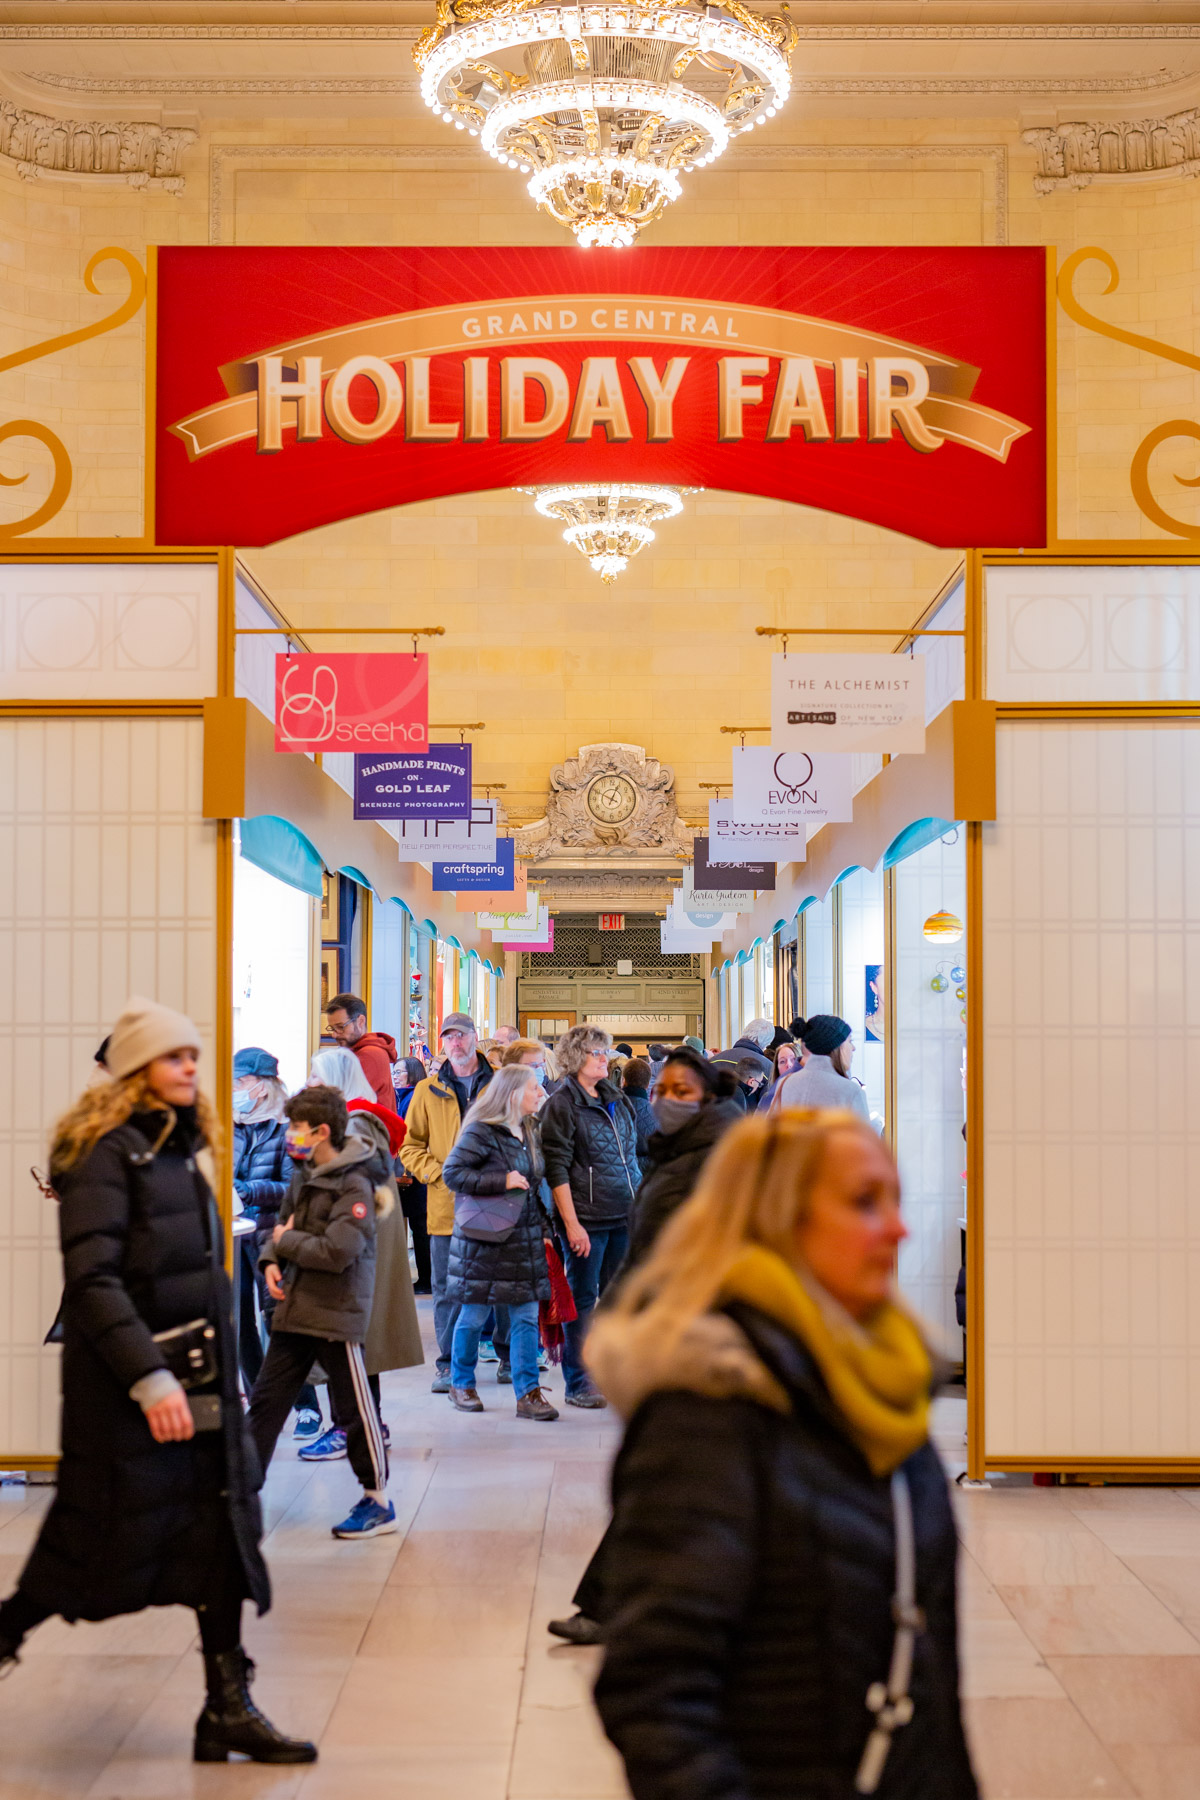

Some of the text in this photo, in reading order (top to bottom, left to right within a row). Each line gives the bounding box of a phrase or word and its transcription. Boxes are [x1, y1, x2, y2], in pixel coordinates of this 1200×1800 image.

[462, 309, 739, 337] GRAND CENTRAL
[257, 355, 945, 454] HOLIDAY FAIR
[788, 680, 909, 690] THE ALCHEMIST
[336, 721, 425, 742] seeka
[361, 760, 466, 777] HANDMADE PRINTS
[375, 784, 451, 793] GOLD LEAF
[769, 790, 818, 804] EVON
[803, 808, 828, 816] Jewelry
[443, 863, 505, 876] craftspring
[602, 914, 622, 930] EXIT
[627, 1014, 673, 1023] PASSAGE
